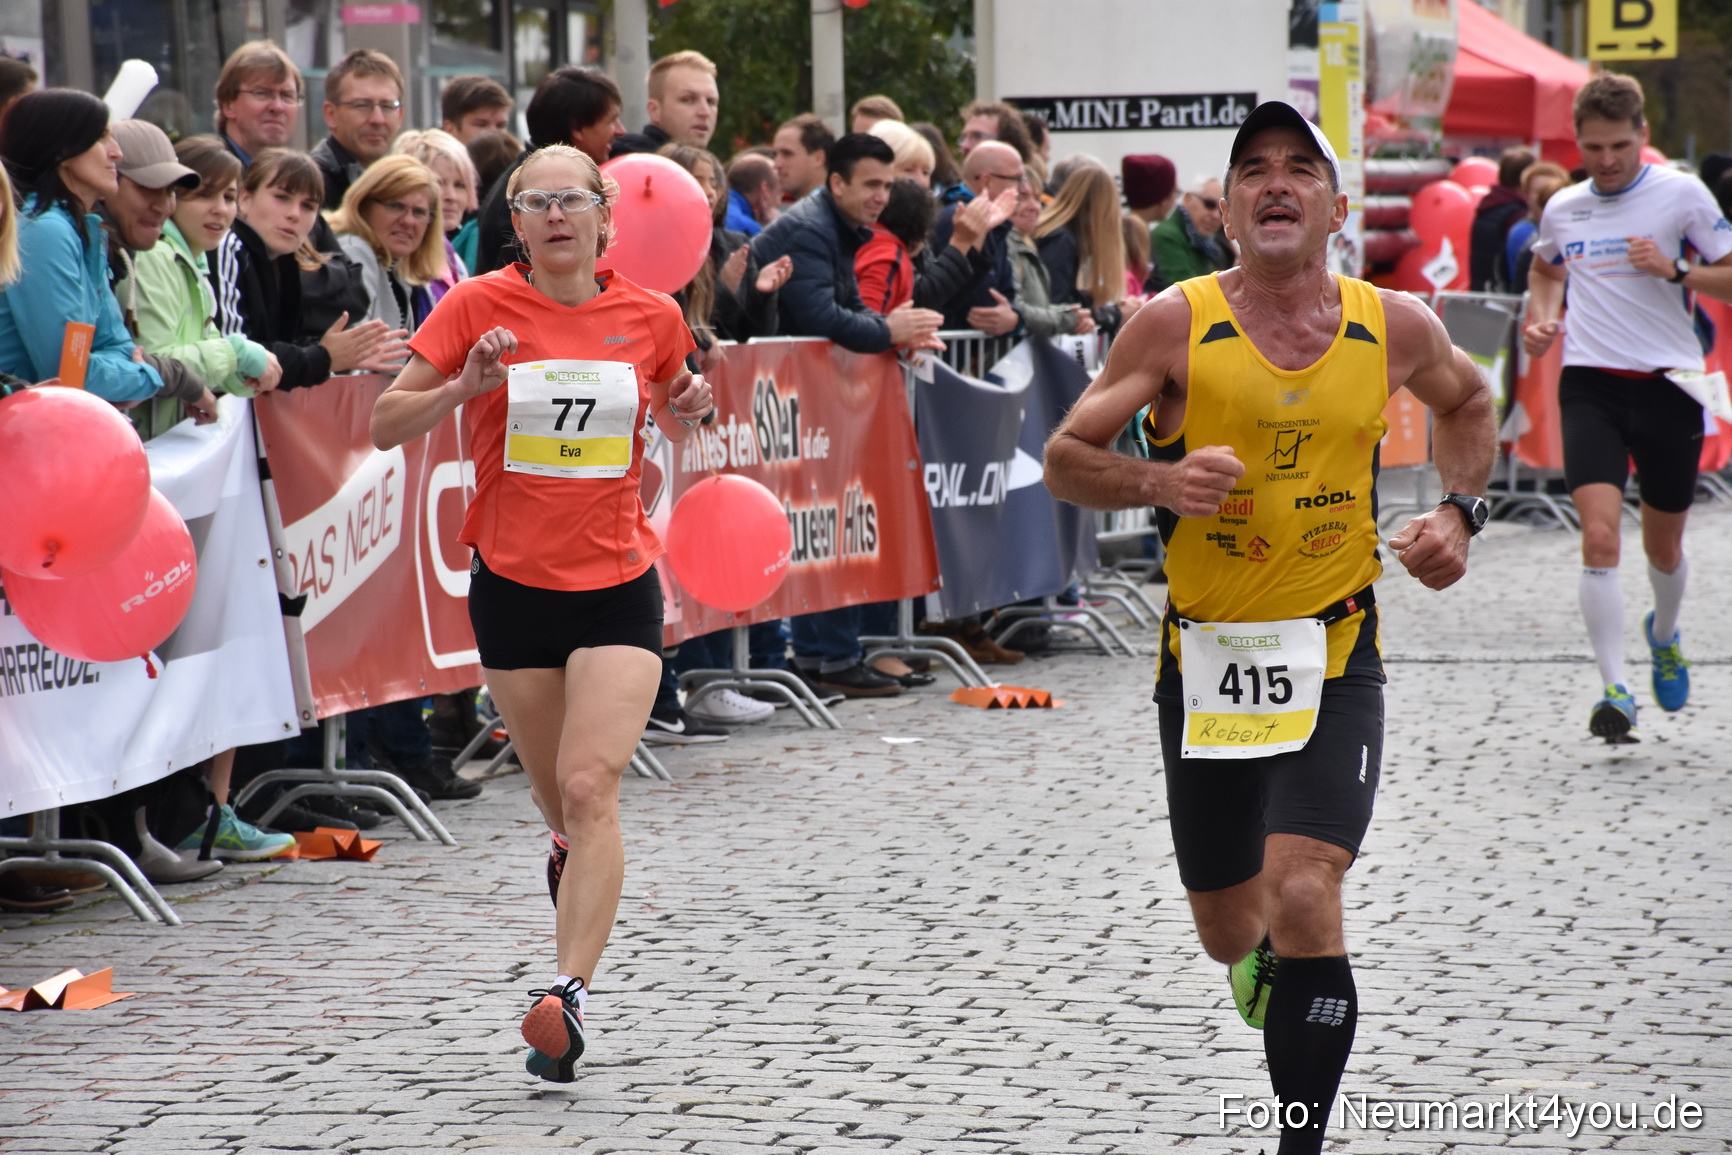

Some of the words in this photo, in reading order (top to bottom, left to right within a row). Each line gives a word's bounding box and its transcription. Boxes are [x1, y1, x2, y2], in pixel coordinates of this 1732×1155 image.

[604, 335, 626, 345] RUN
[558, 371, 601, 382] BOCK
[552, 398, 596, 432] 77
[1257, 418, 1320, 429] FONDSZENTRUM
[560, 445, 581, 458] Eva
[1265, 471, 1310, 482] NEUMARKT
[1228, 487, 1254, 496] einerei
[343, 466, 395, 577] NEUE
[1302, 521, 1348, 543] PIZZERIA
[1310, 533, 1341, 551] ELIO
[1229, 635, 1281, 648] BOCK
[0, 643, 100, 698] HRFREUDE.
[1219, 663, 1292, 705] 415
[1192, 699, 1198, 707] D
[1199, 717, 1280, 743] Robert
[1305, 1014, 1343, 1027] cep
